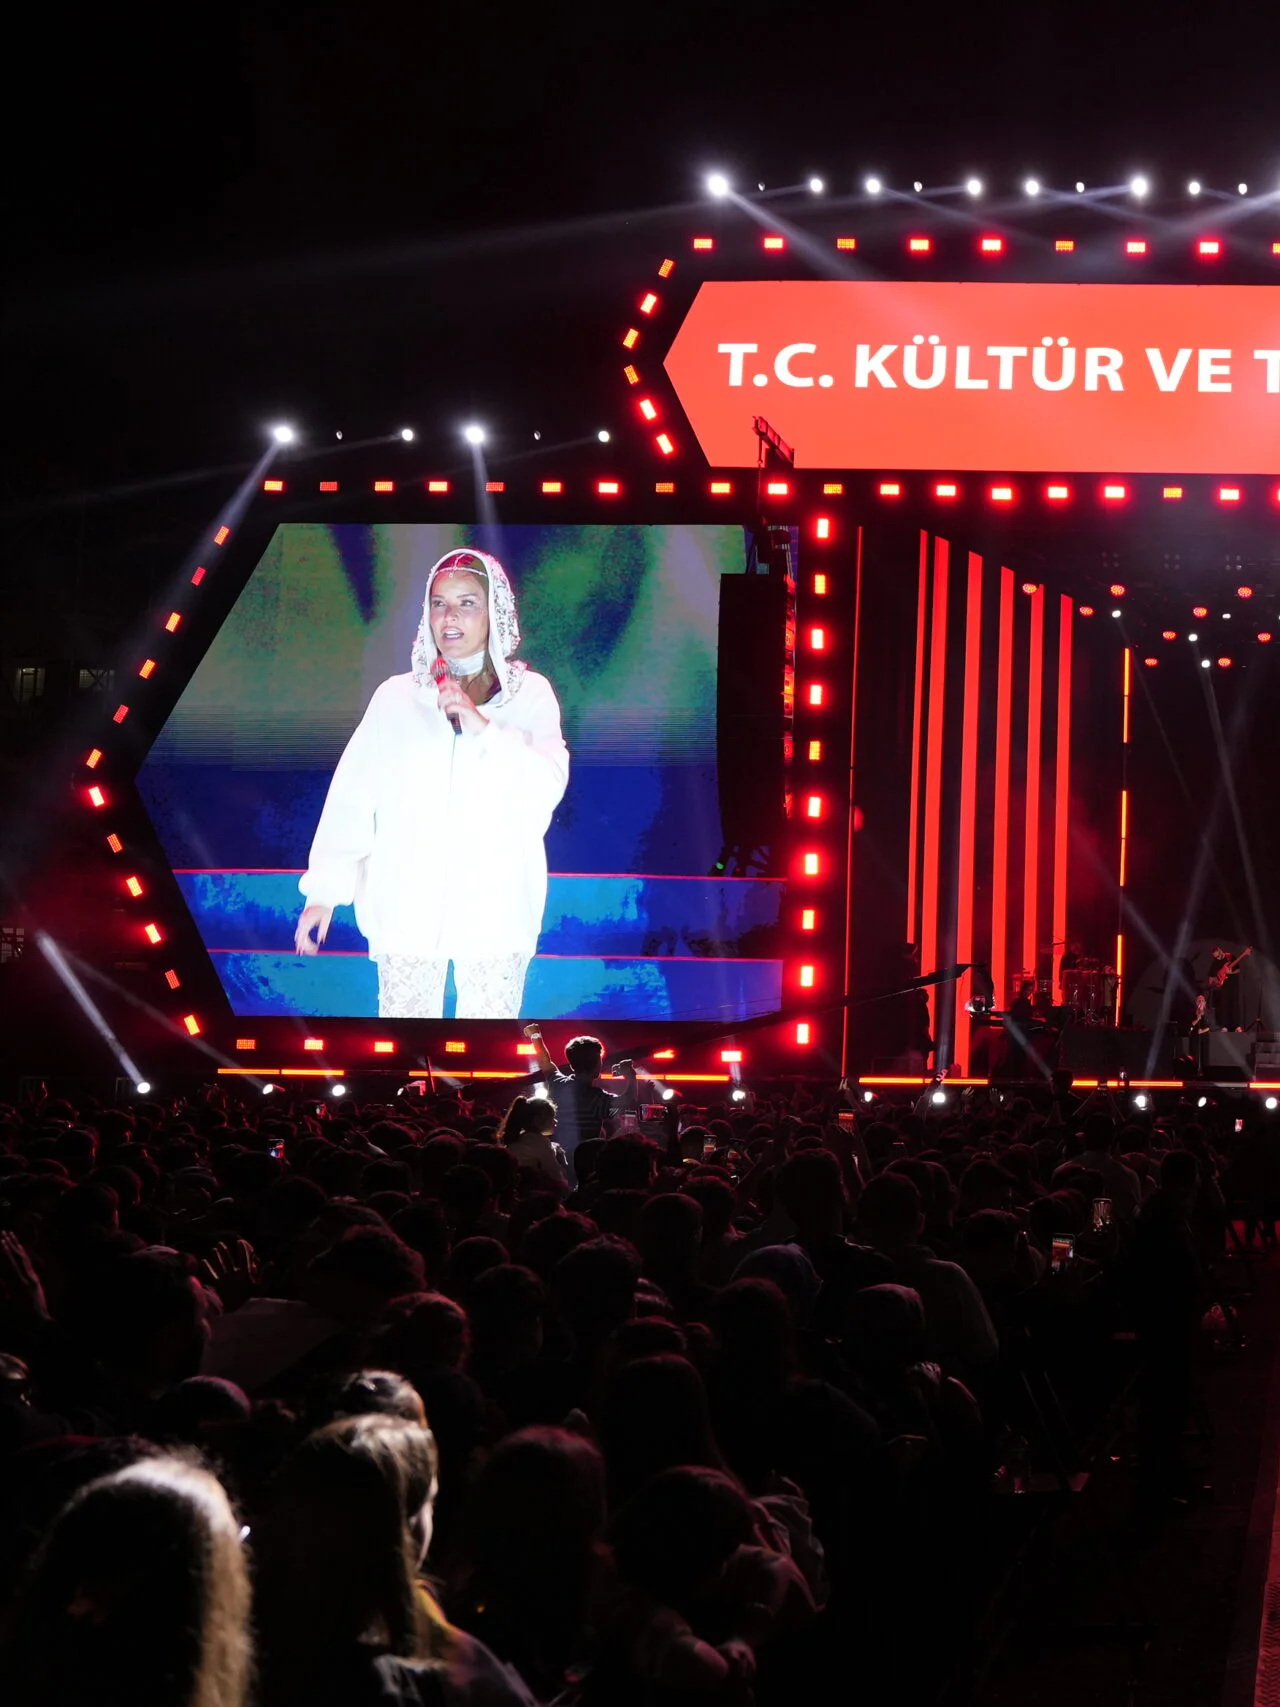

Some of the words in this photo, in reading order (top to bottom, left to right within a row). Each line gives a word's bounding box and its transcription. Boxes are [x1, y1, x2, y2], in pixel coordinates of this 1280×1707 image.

[717, 342, 834, 388] T.C.
[854, 334, 1124, 391] KÜLTÜR
[1145, 347, 1233, 393] VE
